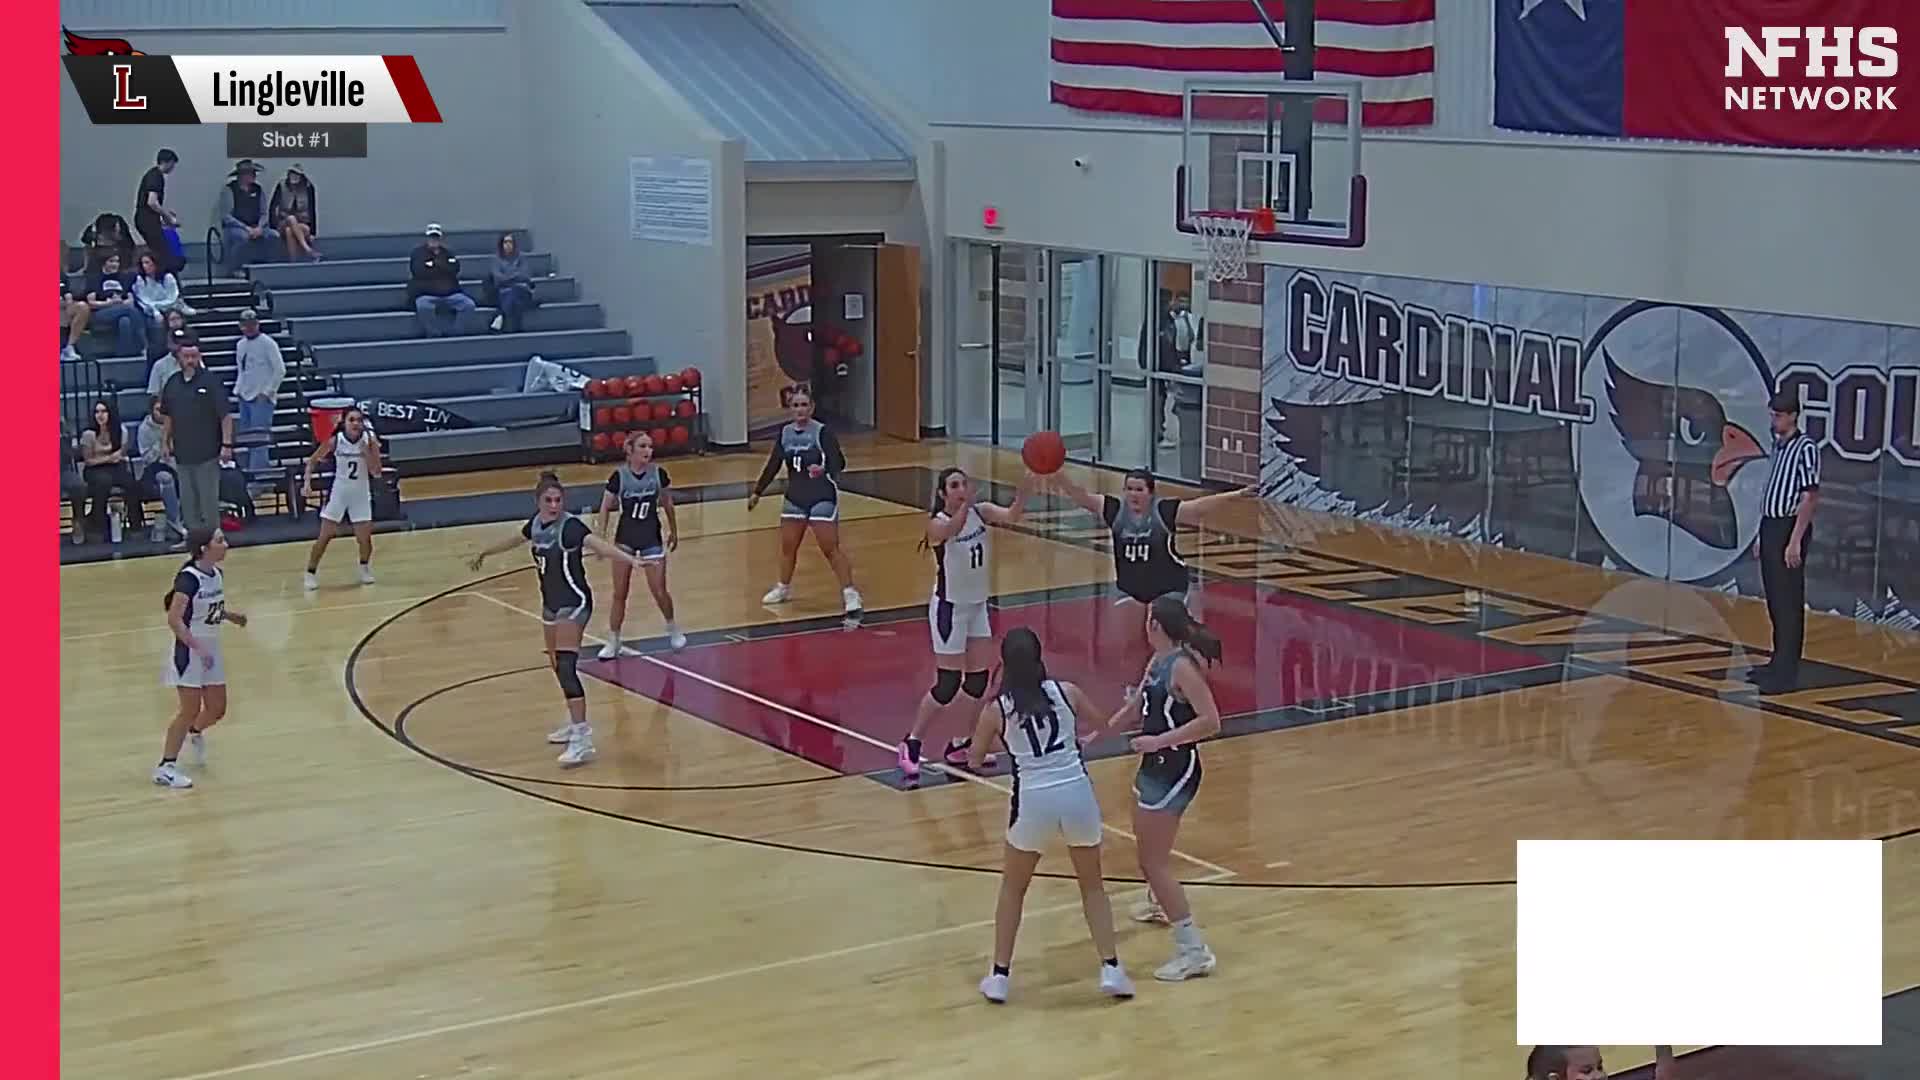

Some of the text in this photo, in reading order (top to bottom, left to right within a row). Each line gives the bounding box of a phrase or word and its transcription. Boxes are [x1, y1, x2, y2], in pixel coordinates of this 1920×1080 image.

[1286, 269, 1597, 424] CARDINAL
[377, 401, 418, 420] BEST
[423, 406, 451, 424] IN
[347, 461, 358, 480] 2
[792, 455, 802, 472] 4
[631, 502, 651, 520] 10
[970, 542, 983, 569] 11
[1125, 544, 1149, 562] 44
[1019, 711, 1065, 758] 12
